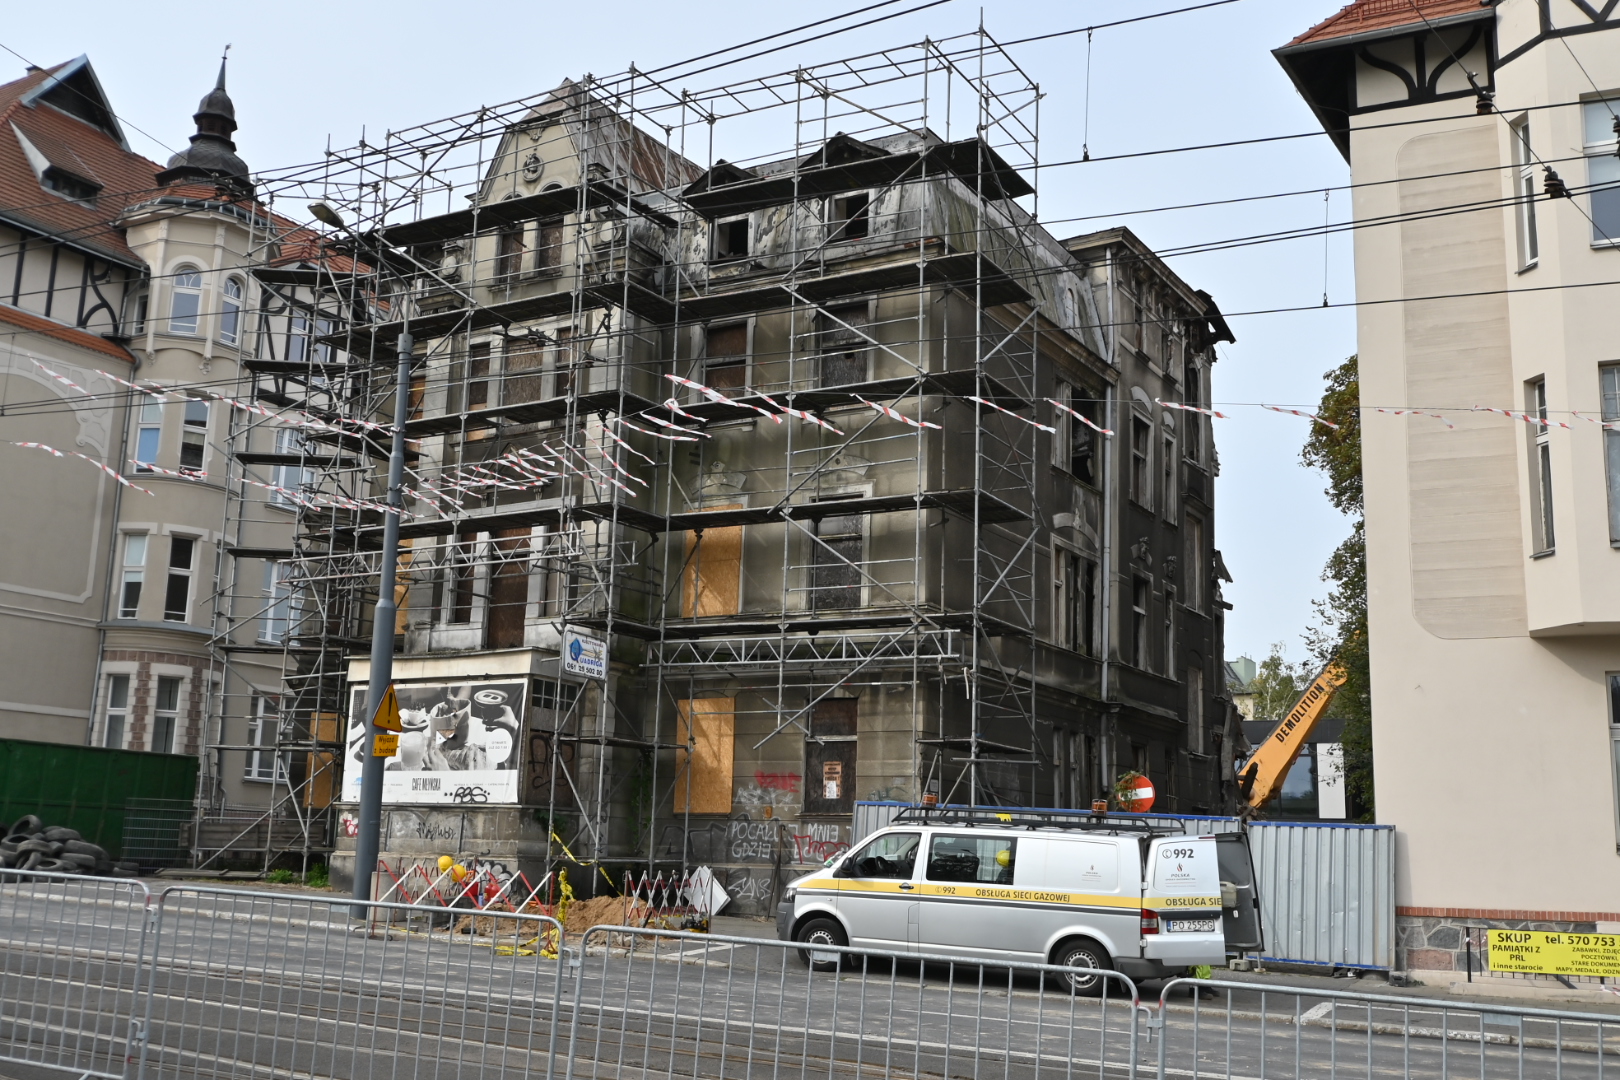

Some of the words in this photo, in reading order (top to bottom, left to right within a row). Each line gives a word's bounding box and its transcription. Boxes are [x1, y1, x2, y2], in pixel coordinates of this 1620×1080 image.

[1275, 682, 1325, 743] DEMOLITION
[412, 777, 422, 791] CAFE
[1173, 848, 1195, 859] 992
[942, 887, 956, 895] 992
[975, 888, 1011, 898] OBSŁUGA
[1013, 891, 1032, 900] SIECI
[1034, 892, 1071, 903] GAZOWEJ
[1165, 897, 1207, 906] OBSŁUGA
[1172, 921, 1185, 930] PO
[1187, 920, 1213, 930] 255PG
[1497, 932, 1532, 944] SKUP
[1545, 934, 1564, 945] tel.
[1567, 935, 1590, 946] 570
[1593, 936, 1616, 947] 753
[1492, 944, 1534, 954] PAMIĄTKI
[1572, 946, 1601, 954] ZABAWKI,
[1509, 953, 1526, 962] PRL
[1514, 963, 1544, 971] starocie
